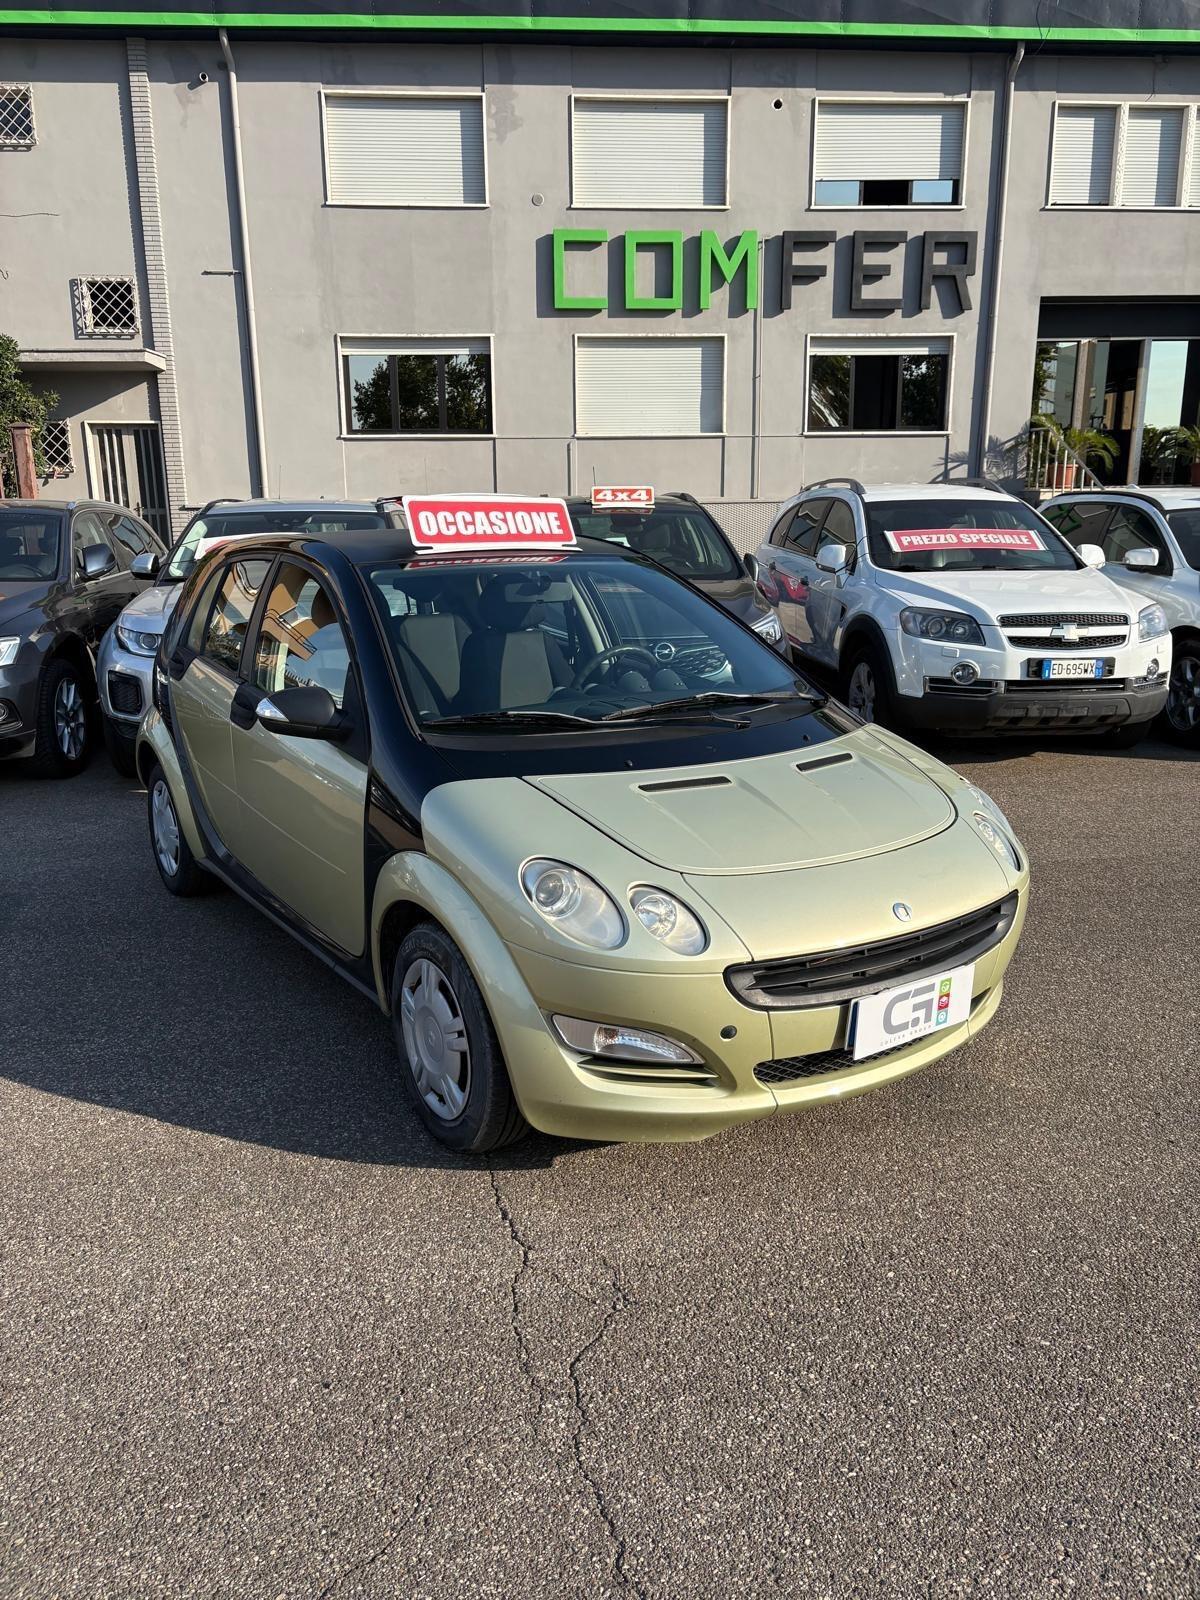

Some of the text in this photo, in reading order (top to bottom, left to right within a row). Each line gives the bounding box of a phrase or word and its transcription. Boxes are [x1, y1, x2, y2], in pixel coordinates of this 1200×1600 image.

[553, 228, 978, 311] COMFER
[596, 489, 650, 501] 4x4
[418, 510, 564, 537] OCCASIONE
[900, 533, 1032, 547] PREZZO SPECIALE
